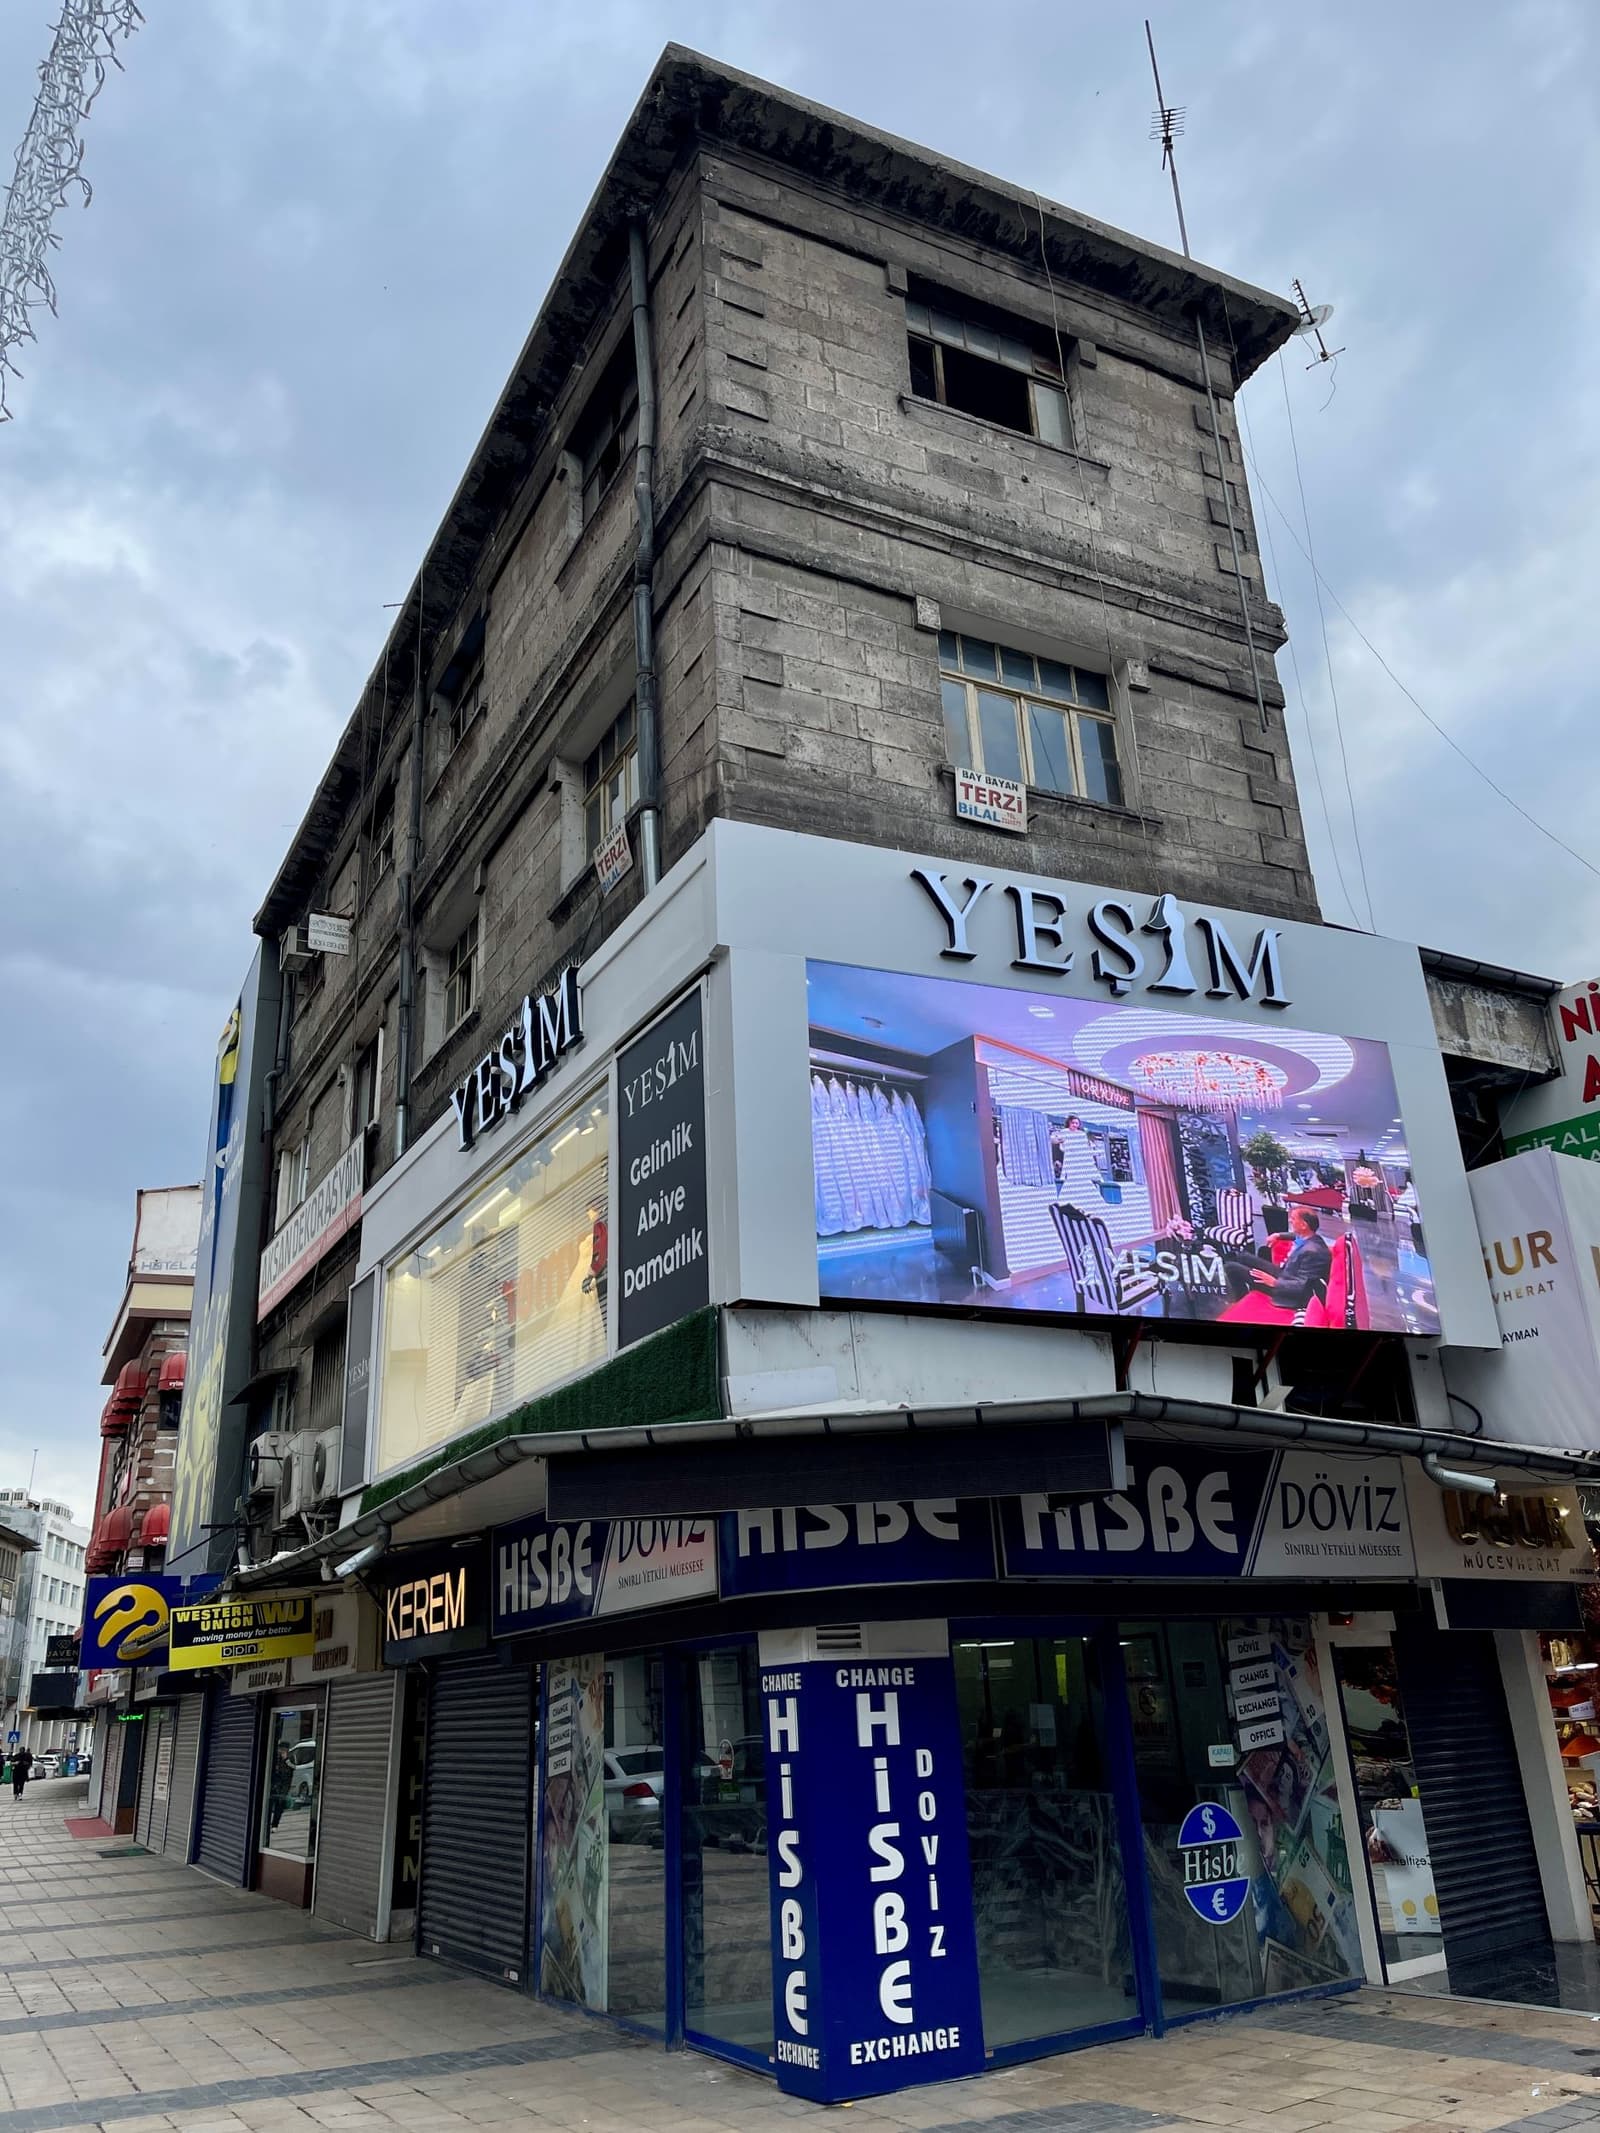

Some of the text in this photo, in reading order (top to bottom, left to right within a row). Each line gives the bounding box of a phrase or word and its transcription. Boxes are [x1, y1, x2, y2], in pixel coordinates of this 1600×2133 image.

[962, 770, 1018, 792] BAY BAYAN
[960, 782, 1022, 814] TERZİ
[630, 1121, 693, 1186] Gelinlik
[637, 1184, 686, 1237] Abiye
[624, 1226, 704, 1299] Damatlık
[1280, 1473, 1401, 1533] DÖVİZ
[1284, 1542, 1320, 1556] SINIRLI
[176, 1605, 254, 1623] WESTERN
[262, 1599, 305, 1625] WU
[386, 1567, 466, 1642] KEREM
[193, 1625, 292, 1644] moving money for better
[200, 1616, 254, 1632] UNION
[47, 1650, 79, 1658] JAVEN
[762, 1672, 802, 1693] CHANGE
[835, 1667, 916, 1688] CHANGE
[1239, 1668, 1270, 1684] CHANGE
[1238, 1696, 1278, 1715] EXCHANGE
[1249, 1727, 1276, 1743] OFFICE
[1182, 1844, 1248, 1883] Hisbe
[777, 2039, 820, 2070] EXCHANGE
[850, 2026, 961, 2065] EXCHANGE
